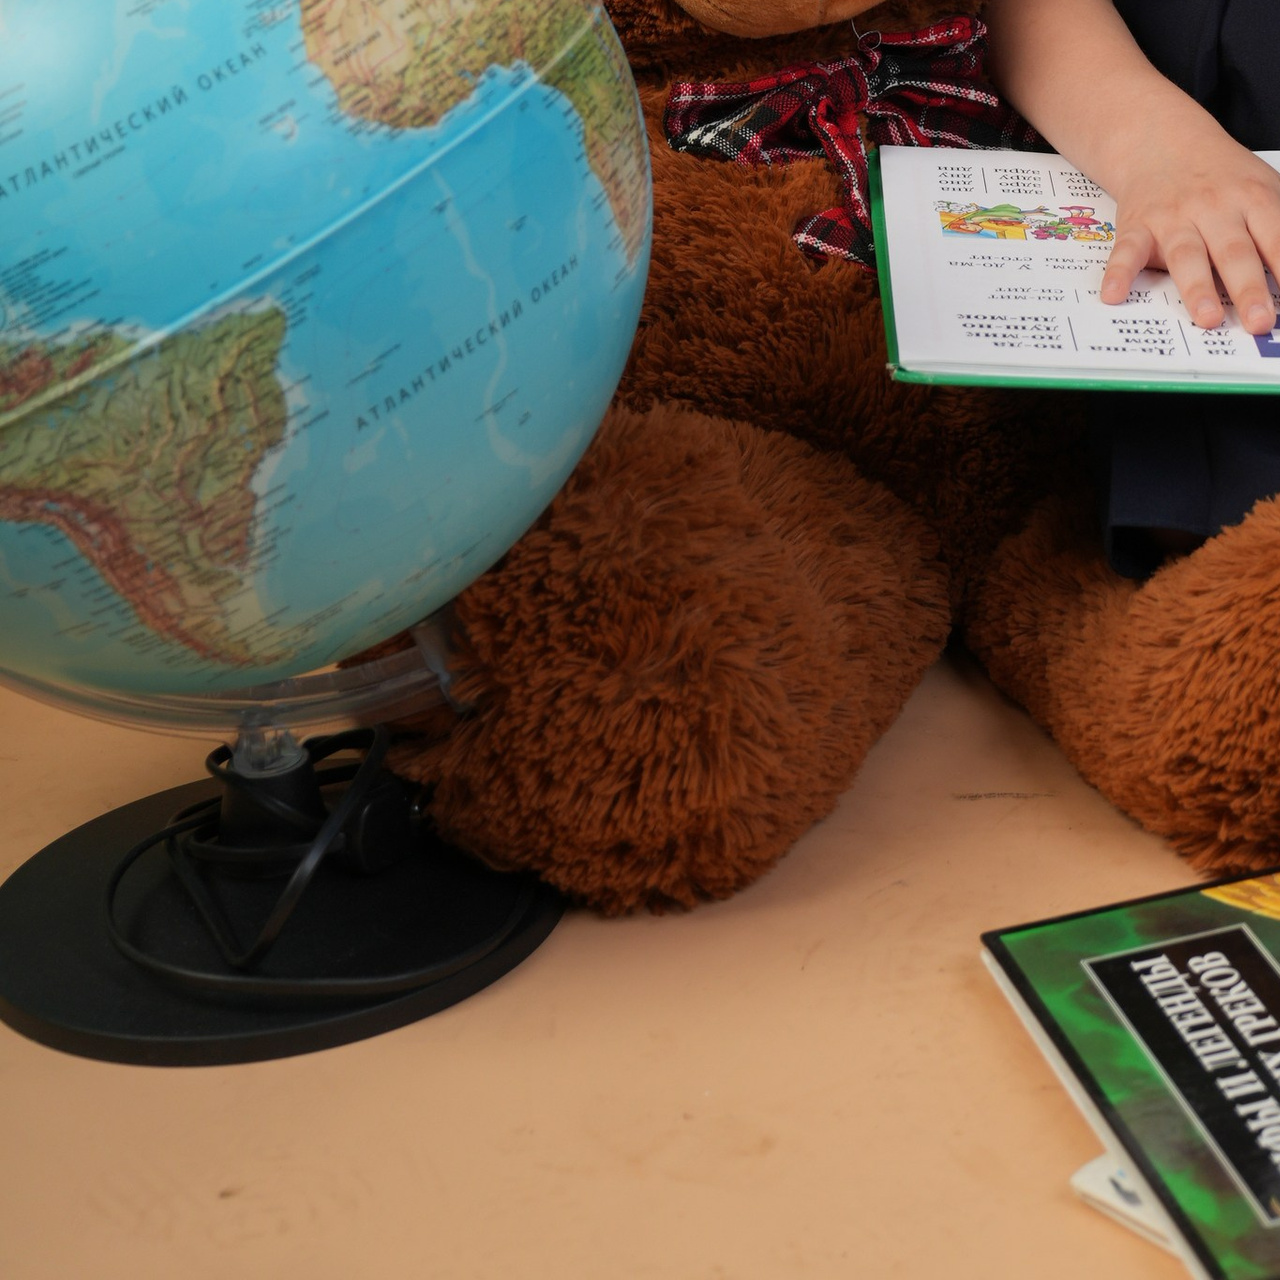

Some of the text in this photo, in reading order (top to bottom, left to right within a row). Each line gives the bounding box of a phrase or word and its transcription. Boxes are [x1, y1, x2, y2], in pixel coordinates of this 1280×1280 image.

[197, 42, 269, 92] ОКЕАН
[949, 260, 1005, 269] до-ма
[988, 294, 1065, 302] ды-мит
[956, 314, 1057, 323] ды-мок
[962, 322, 1059, 332] душ-но
[1119, 327, 1171, 336] душ
[965, 331, 1061, 341] до-мик
[355, 298, 525, 432] АТЛАНТИЧЕСКИЙ
[530, 254, 579, 306] ОКЕАН
[992, 340, 1062, 350] во-да
[1088, 345, 1176, 357] Да-ша
[1129, 953, 1249, 1073] ЛЕГЕНДЫ
[1215, 1068, 1268, 1100] И
